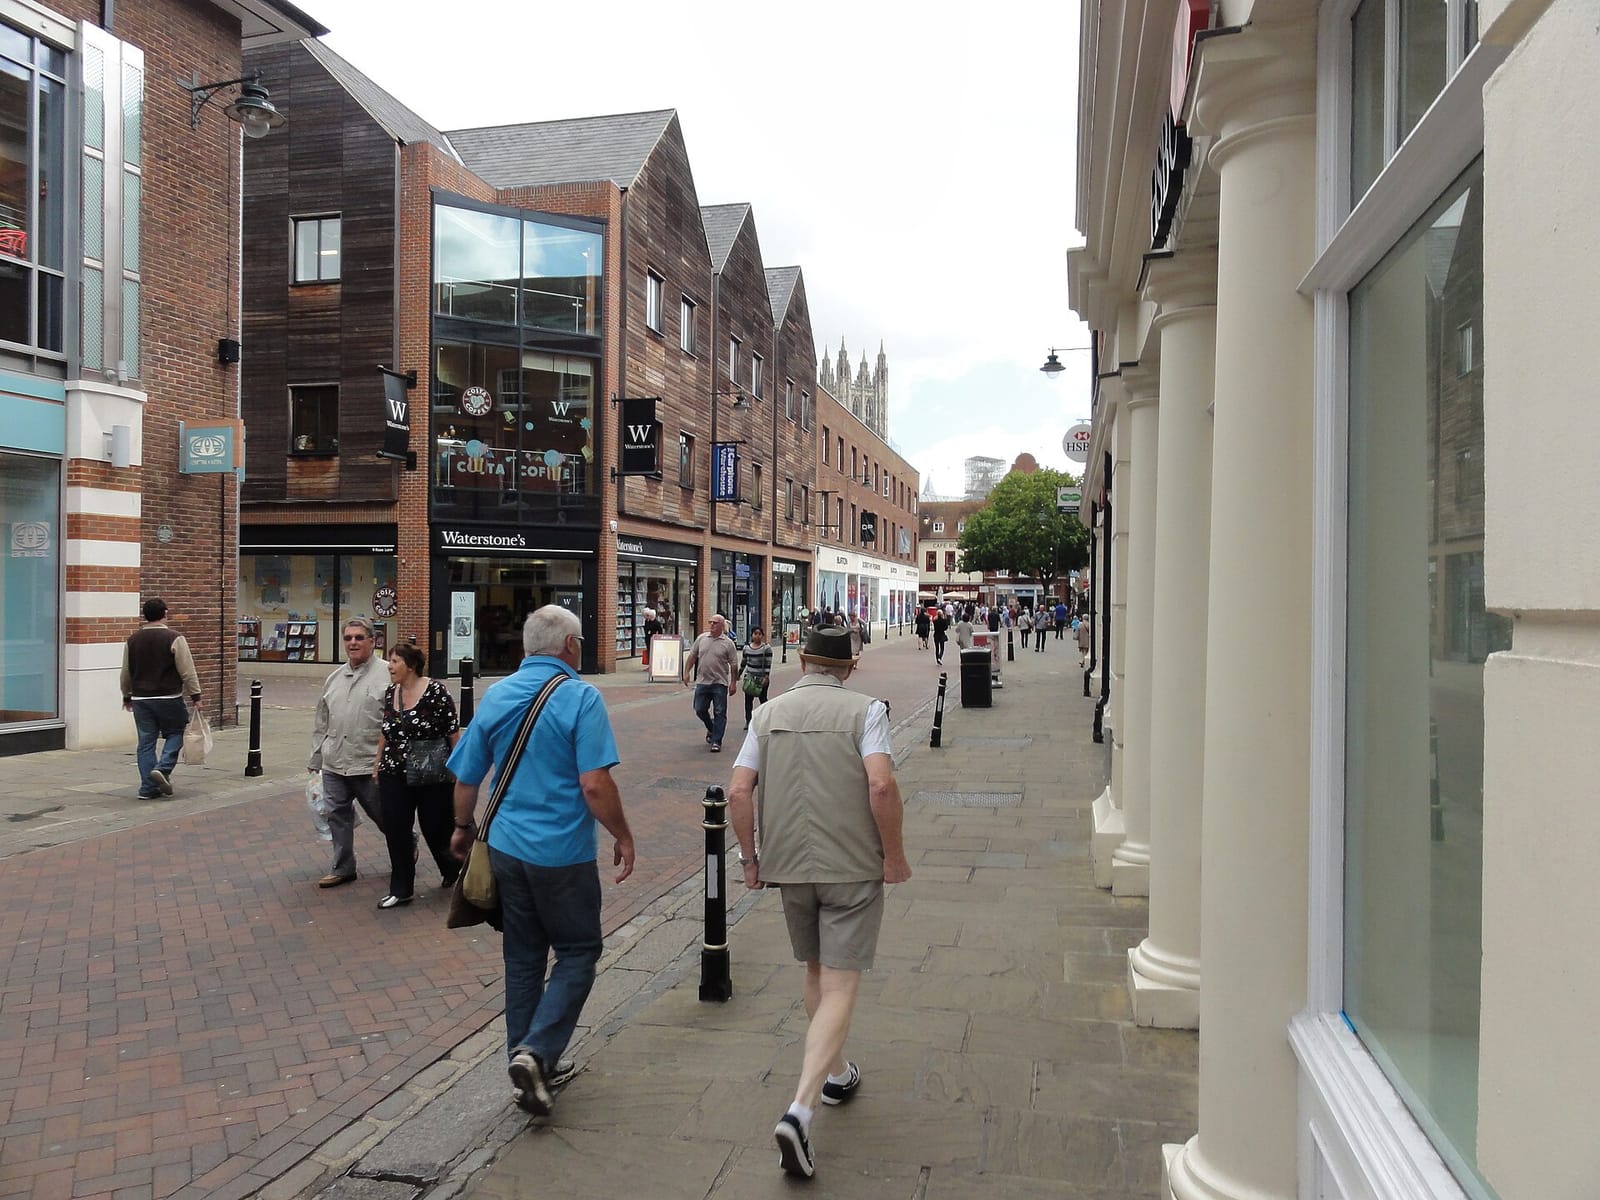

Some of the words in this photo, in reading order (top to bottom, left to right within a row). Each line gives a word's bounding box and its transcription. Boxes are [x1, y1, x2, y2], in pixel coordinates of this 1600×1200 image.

[466, 387, 488, 397] COSTA
[387, 399, 407, 422] W
[465, 403, 489, 416] COFFEE
[551, 401, 570, 416] W
[627, 424, 652, 442] W
[1066, 442, 1089, 451] HSB
[720, 447, 728, 496] Warehouse
[727, 452, 735, 494] Carphone
[442, 531, 526, 547] Waterstone's
[376, 589, 395, 598] COSTA
